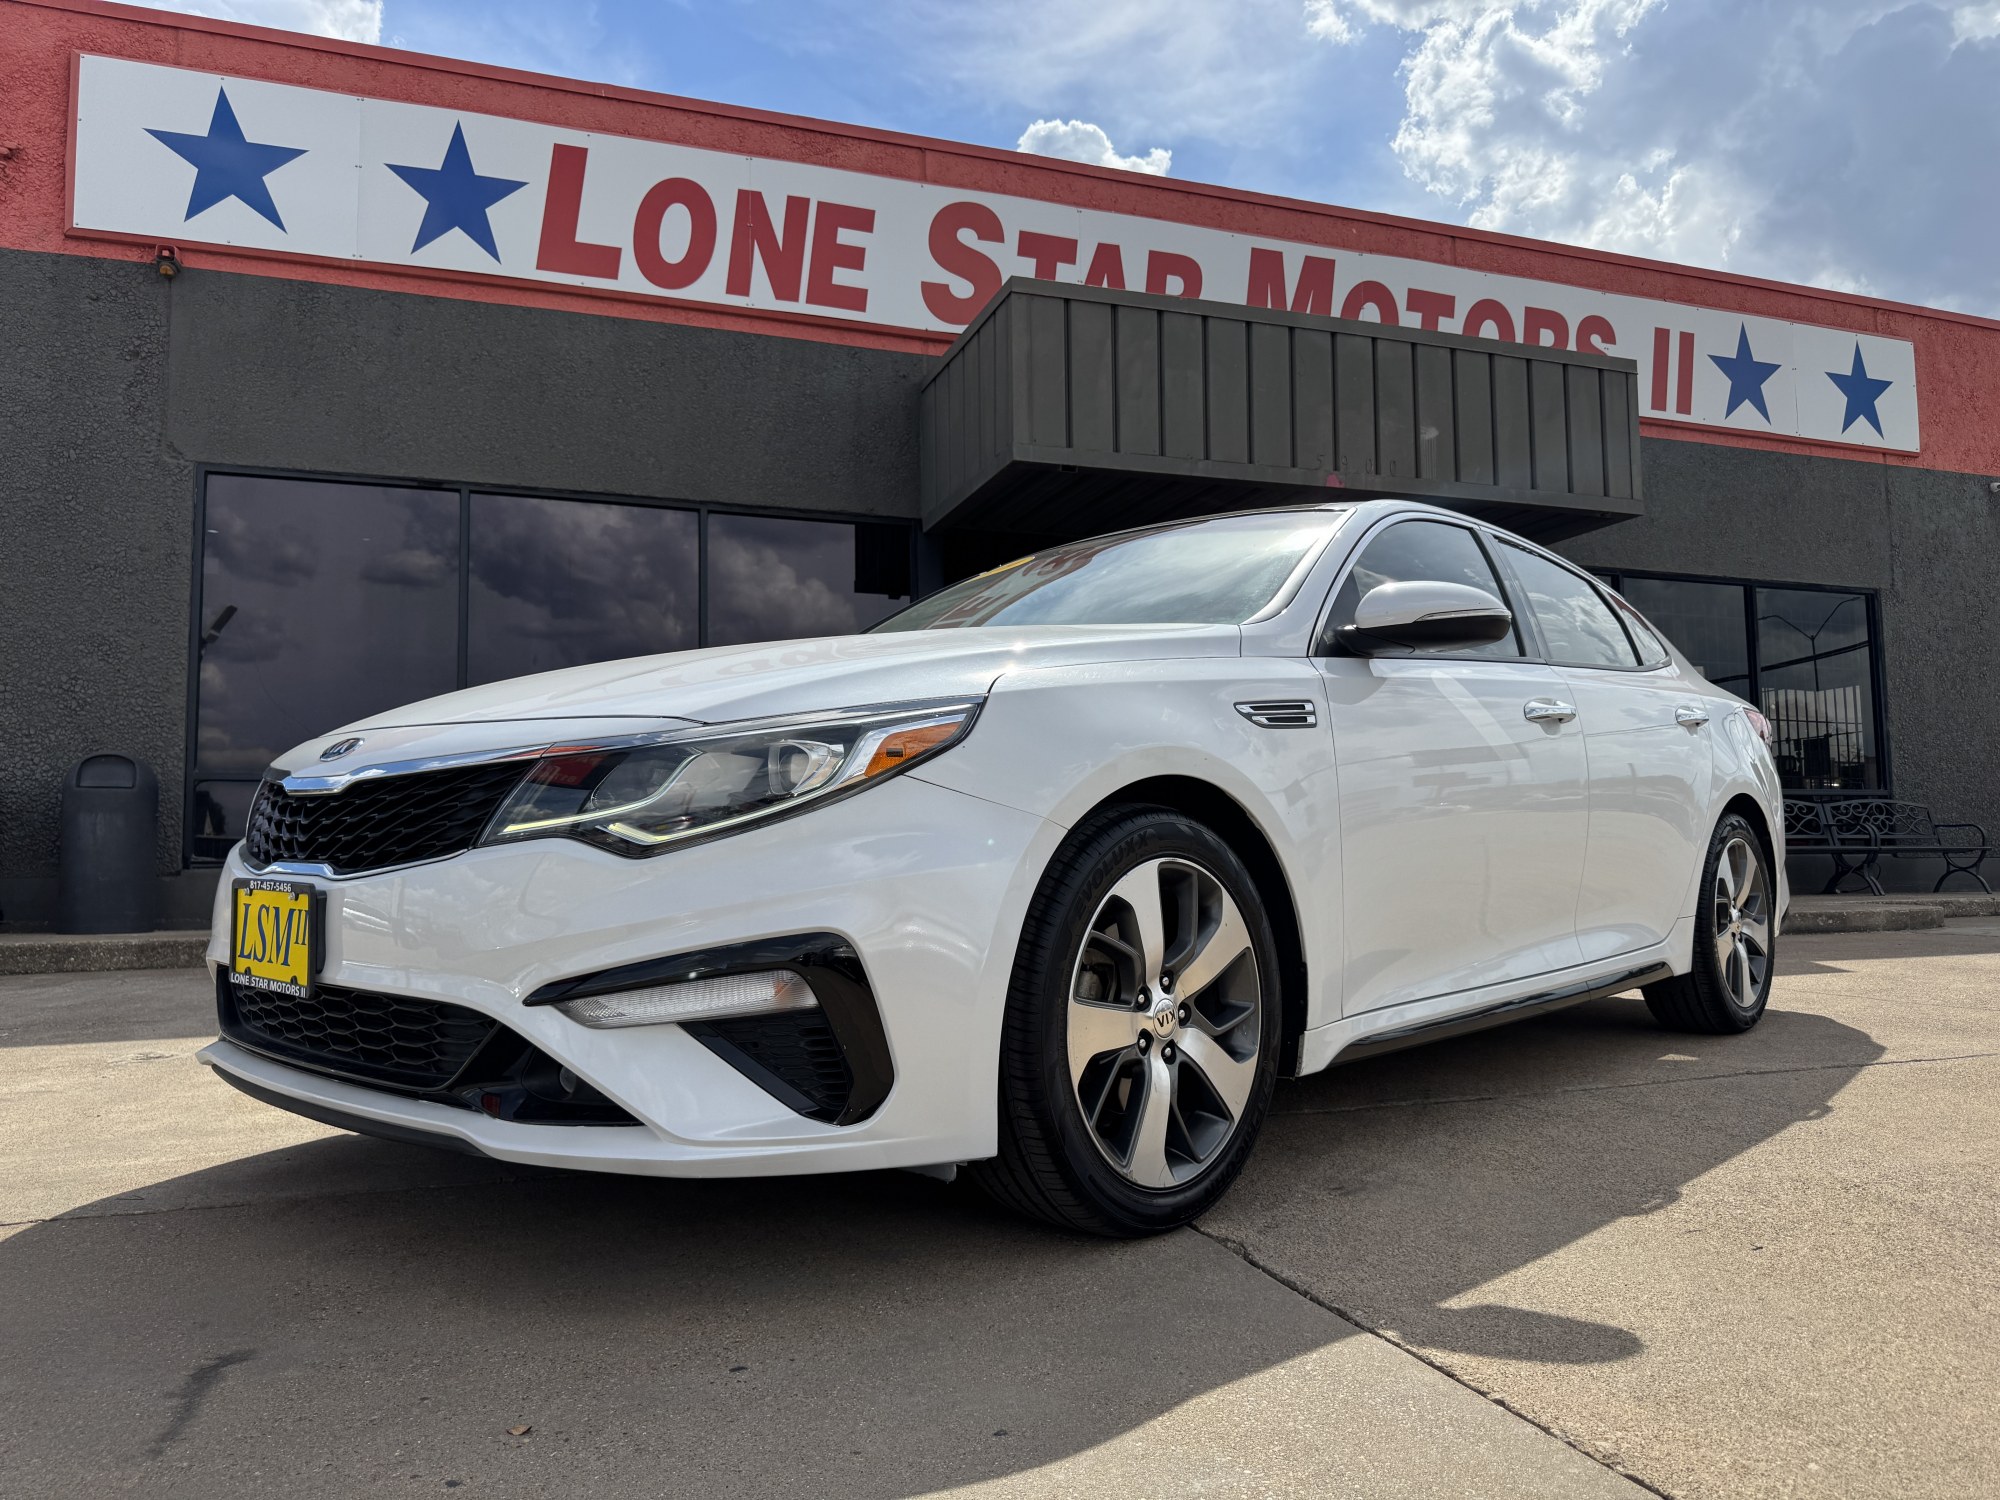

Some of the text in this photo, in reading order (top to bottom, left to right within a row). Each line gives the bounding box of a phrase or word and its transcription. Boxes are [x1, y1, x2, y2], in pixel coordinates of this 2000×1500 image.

[536, 143, 876, 313] LONE
[1650, 327, 1695, 415] II
[249, 880, 292, 892] 817-457-5456
[231, 972, 249, 985] LONE
[251, 976, 268, 990] STAR
[269, 980, 300, 997] MOTORS
